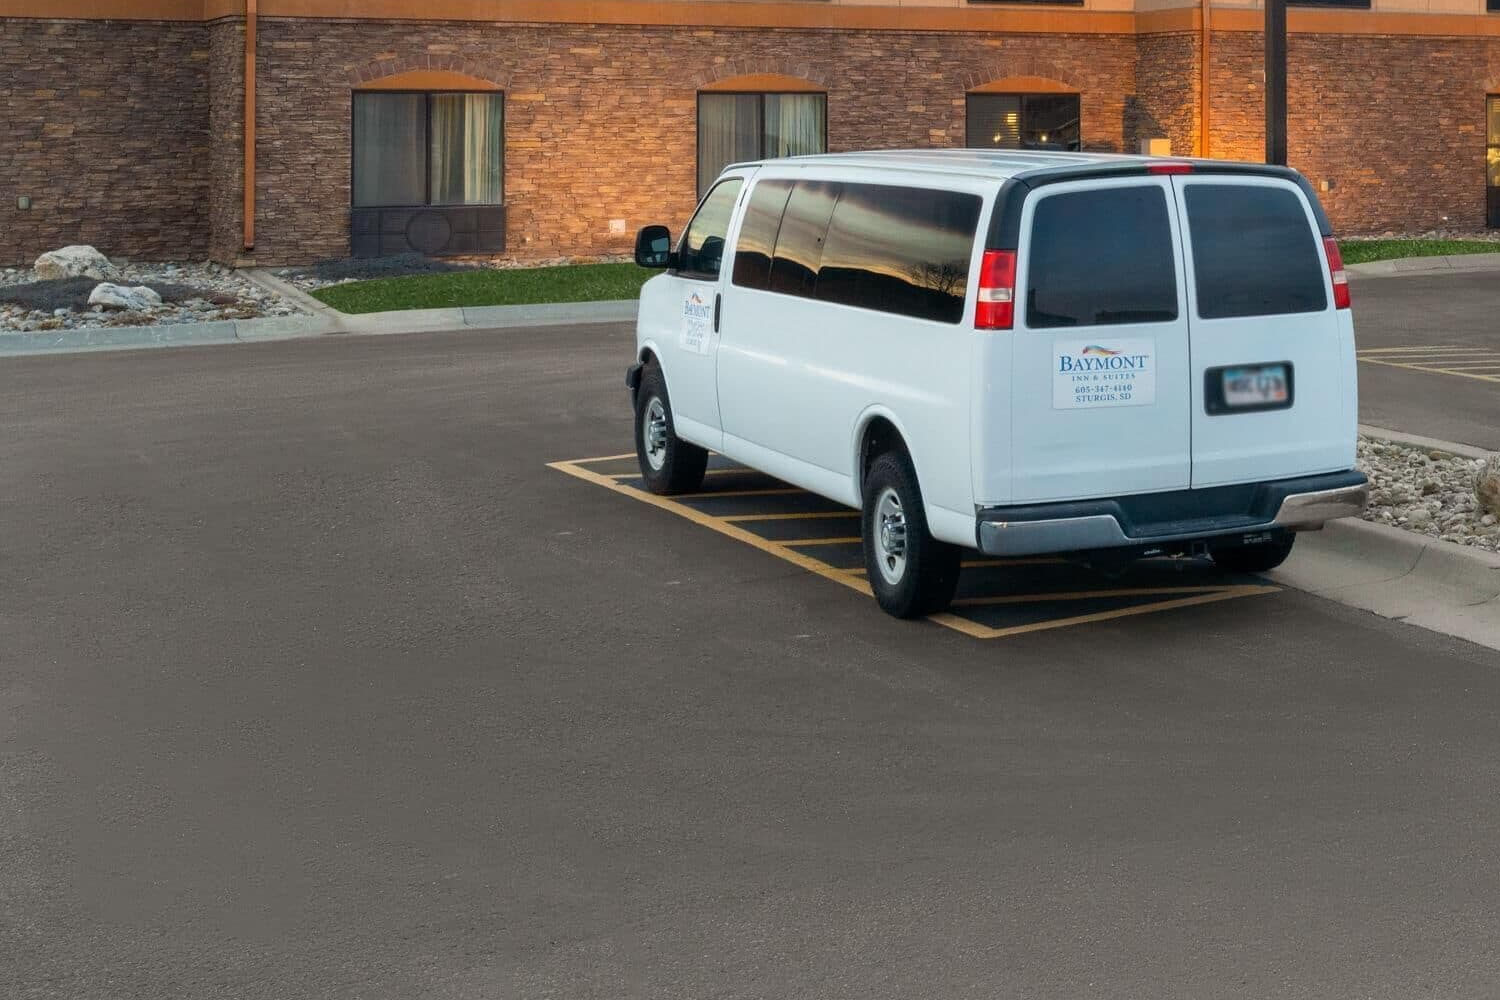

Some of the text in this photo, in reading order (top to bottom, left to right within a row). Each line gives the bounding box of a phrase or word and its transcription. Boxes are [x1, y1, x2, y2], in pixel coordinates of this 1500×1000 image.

[1059, 355, 1147, 372] BAYMONT
[1103, 373, 1136, 381] SUITES
[1120, 393, 1132, 401] SD
